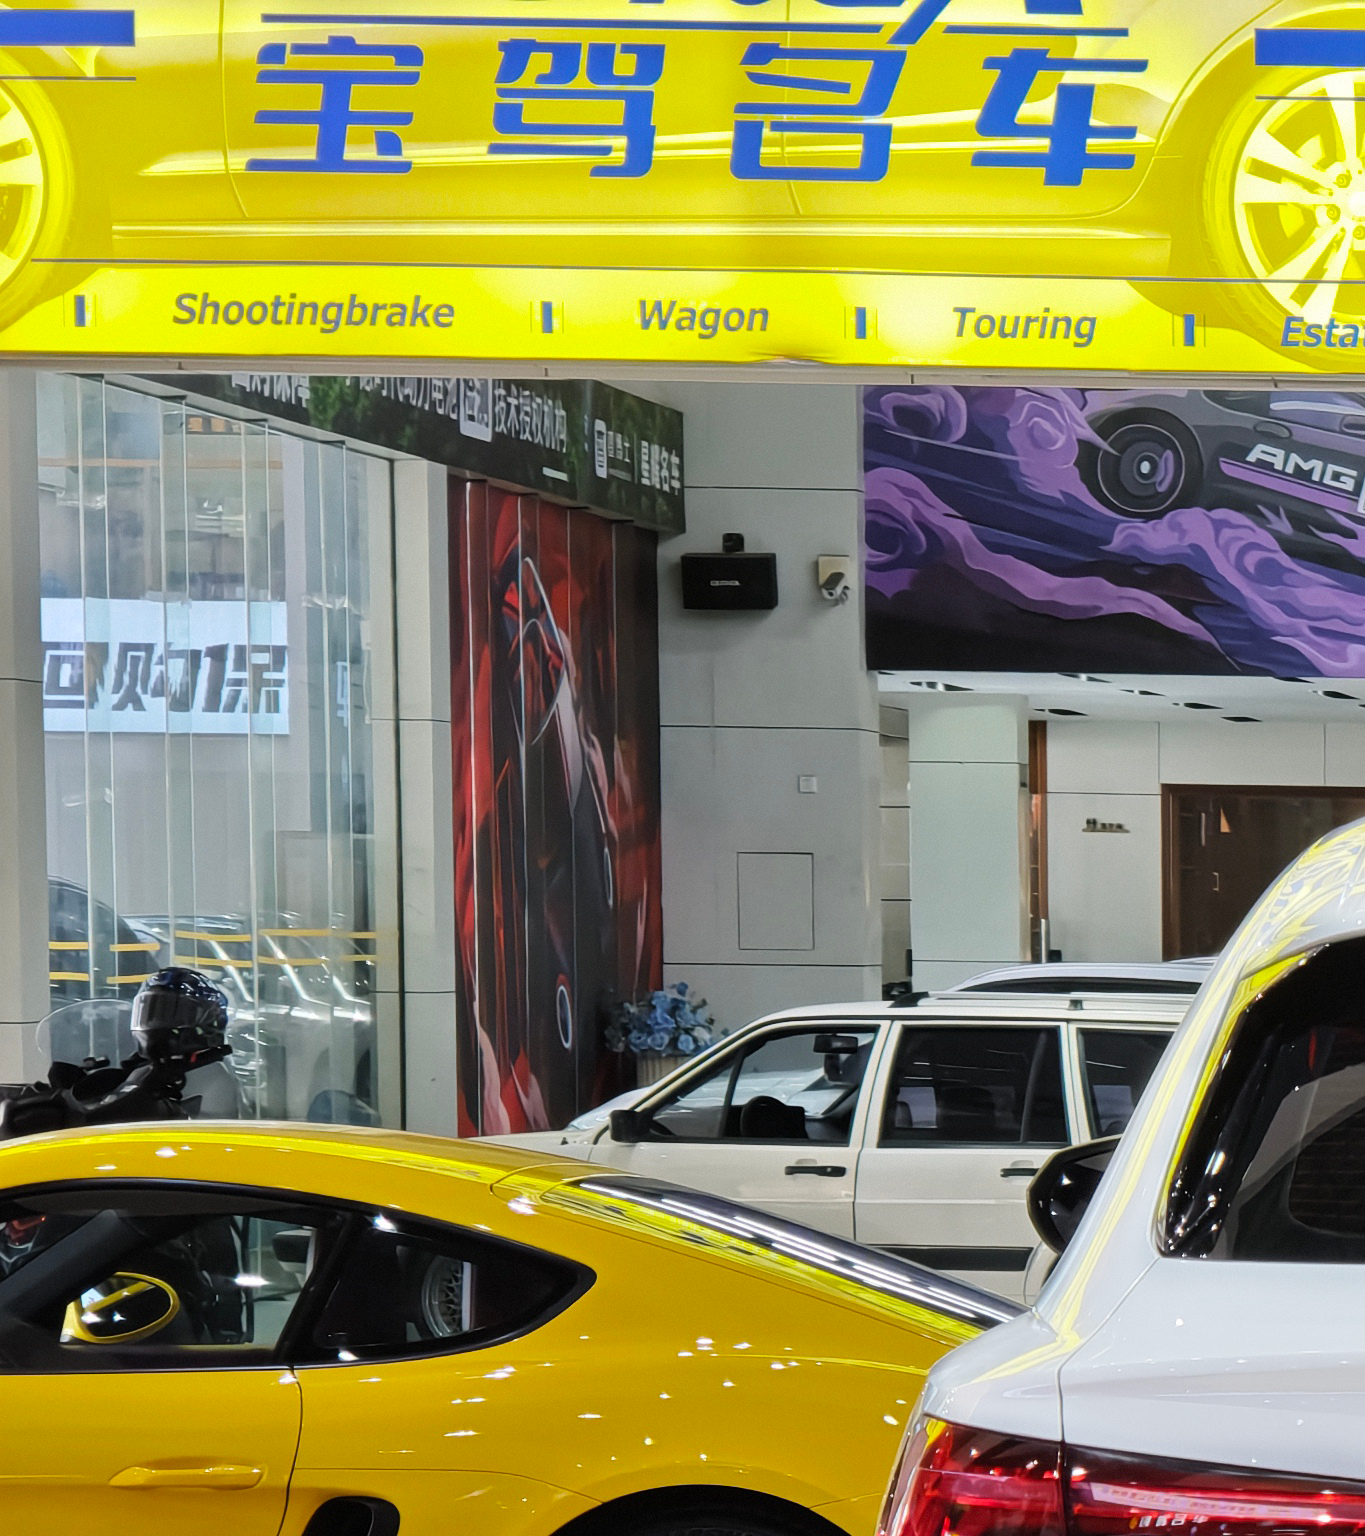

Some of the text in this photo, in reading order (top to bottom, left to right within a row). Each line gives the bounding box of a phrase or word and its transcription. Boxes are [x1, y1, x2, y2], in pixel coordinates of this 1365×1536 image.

[246, 34, 1150, 188] 宝驾名车
[172, 293, 456, 335] Shootingbrake
[638, 299, 770, 339] Wagon
[952, 307, 1098, 349] Touring
[493, 380, 568, 454] 技术授权机构
[1245, 441, 1358, 492] AMG
